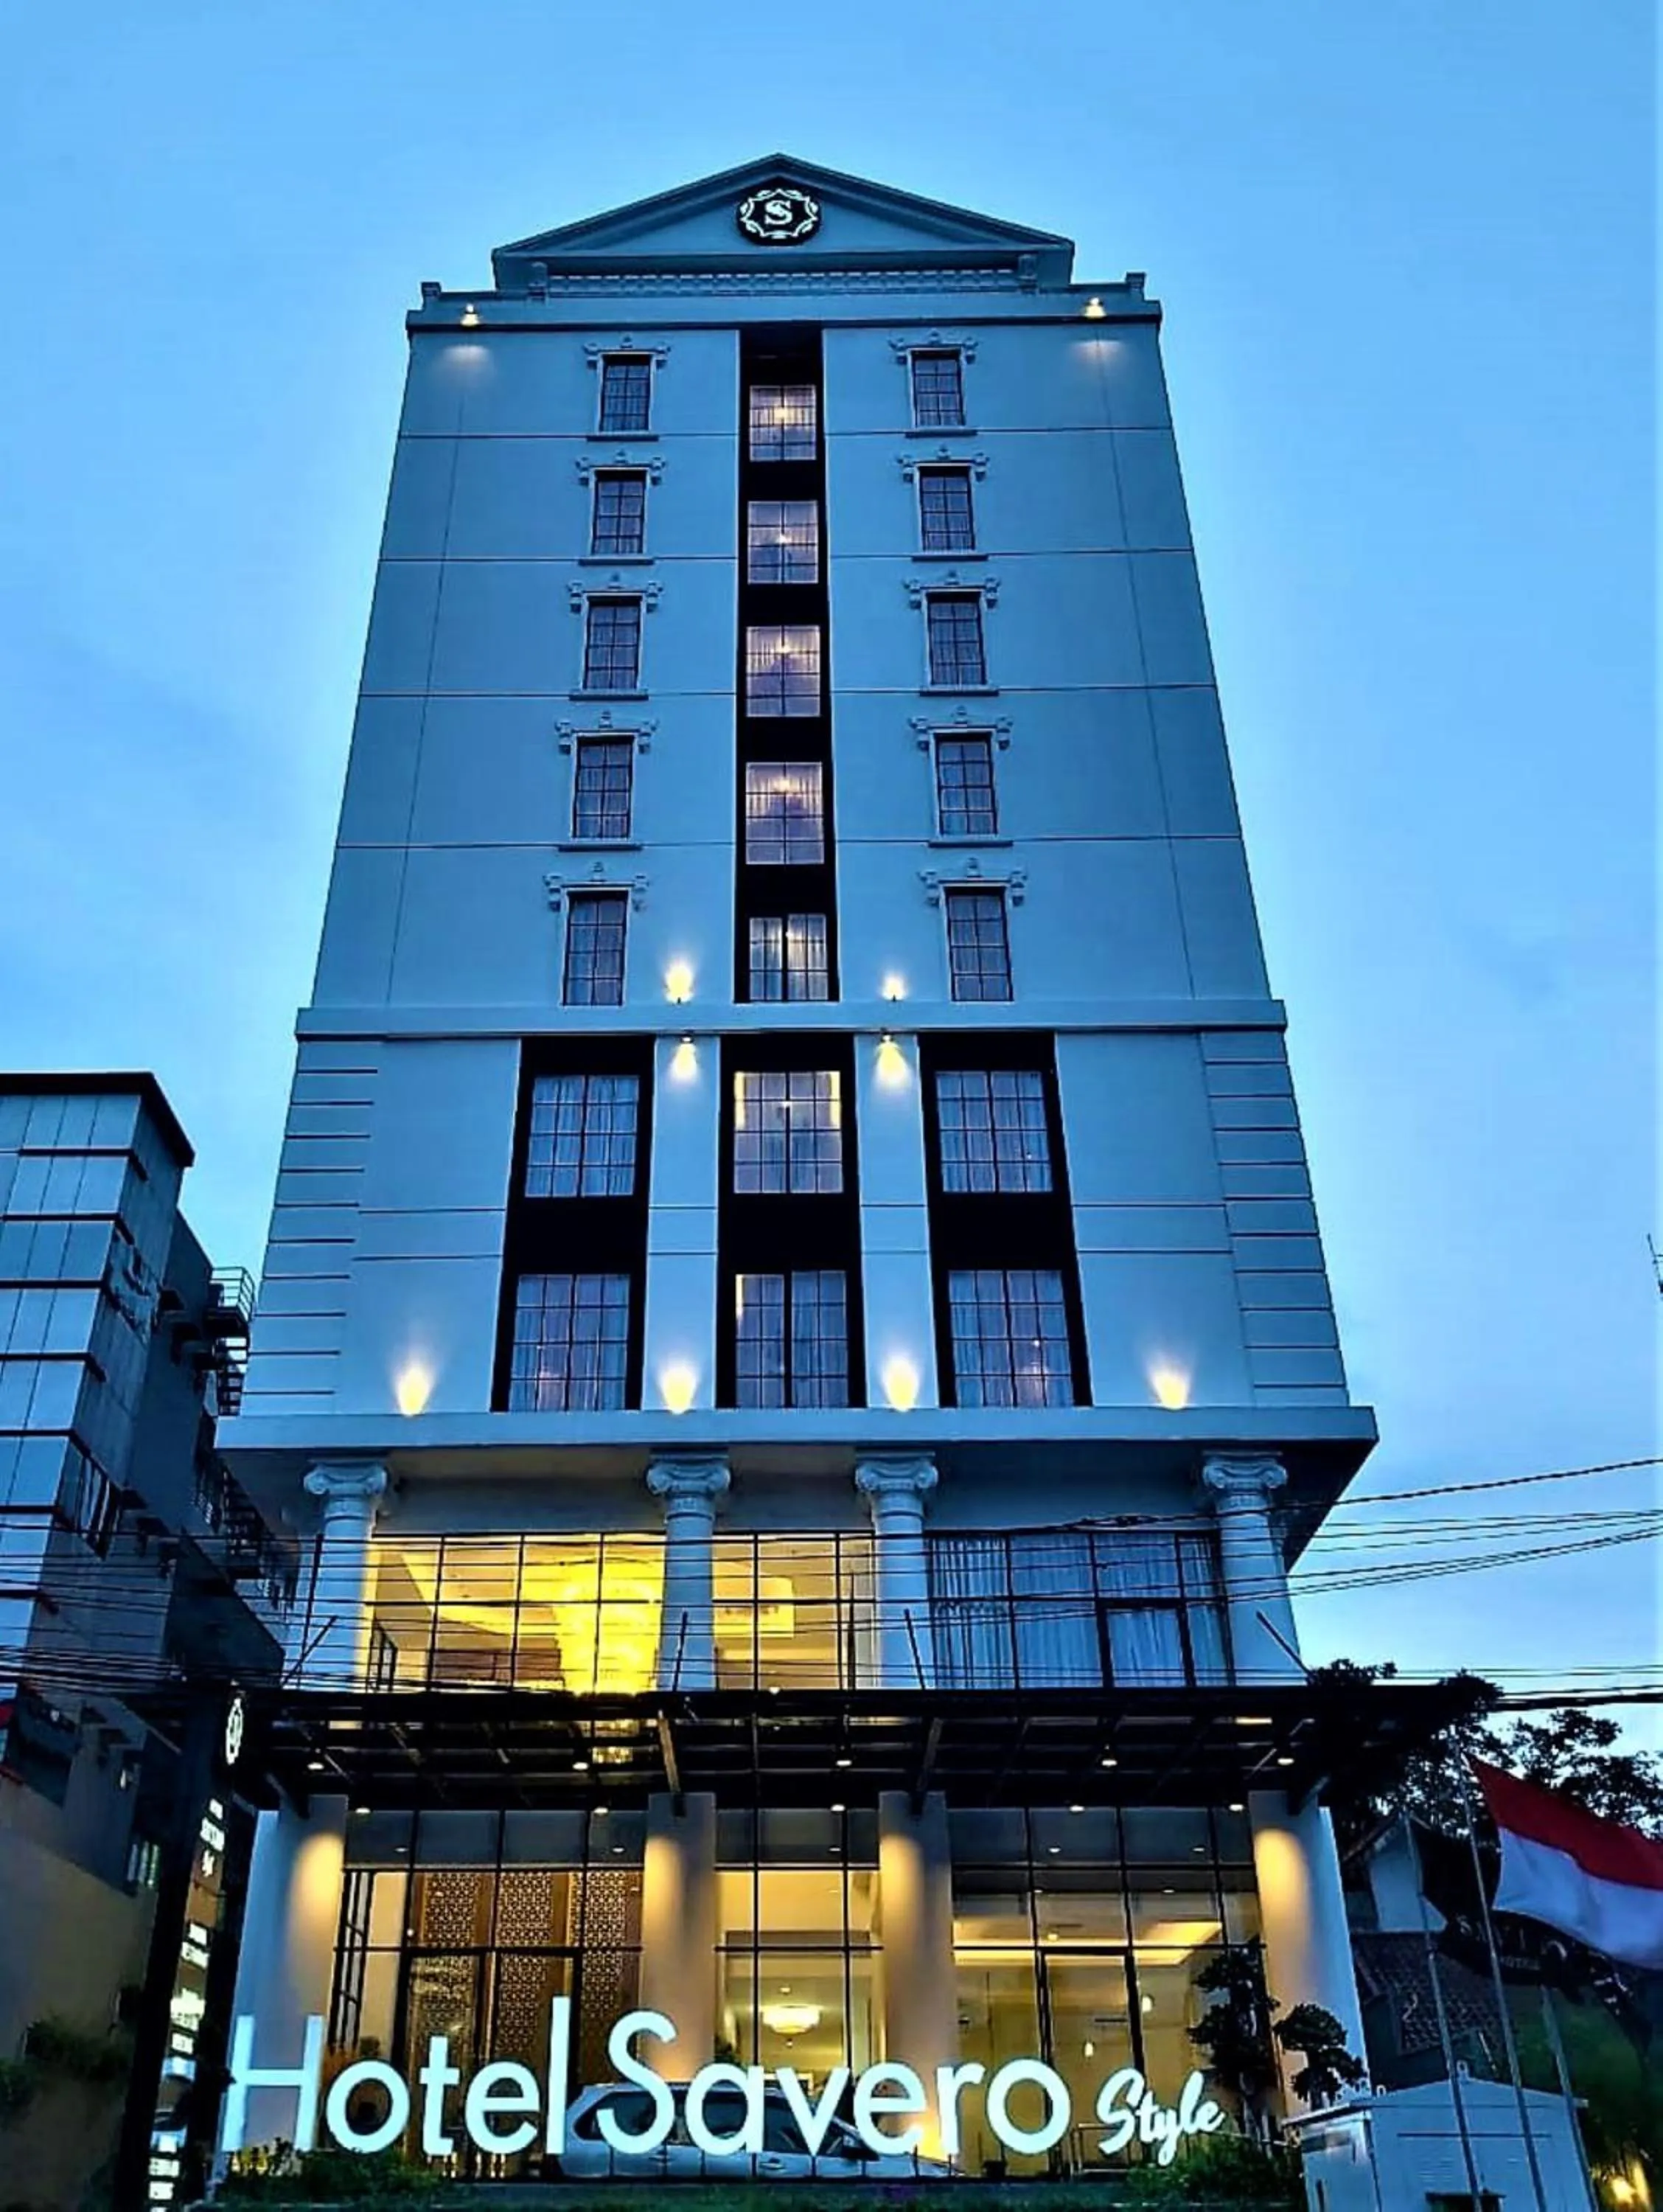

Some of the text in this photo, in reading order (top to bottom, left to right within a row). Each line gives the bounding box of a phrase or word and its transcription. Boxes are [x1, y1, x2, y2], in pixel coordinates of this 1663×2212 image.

[764, 200, 792, 225] S
[221, 1995, 571, 2155] Hotel
[596, 2011, 1071, 2156] Savero
[1096, 2067, 1225, 2166] Style
